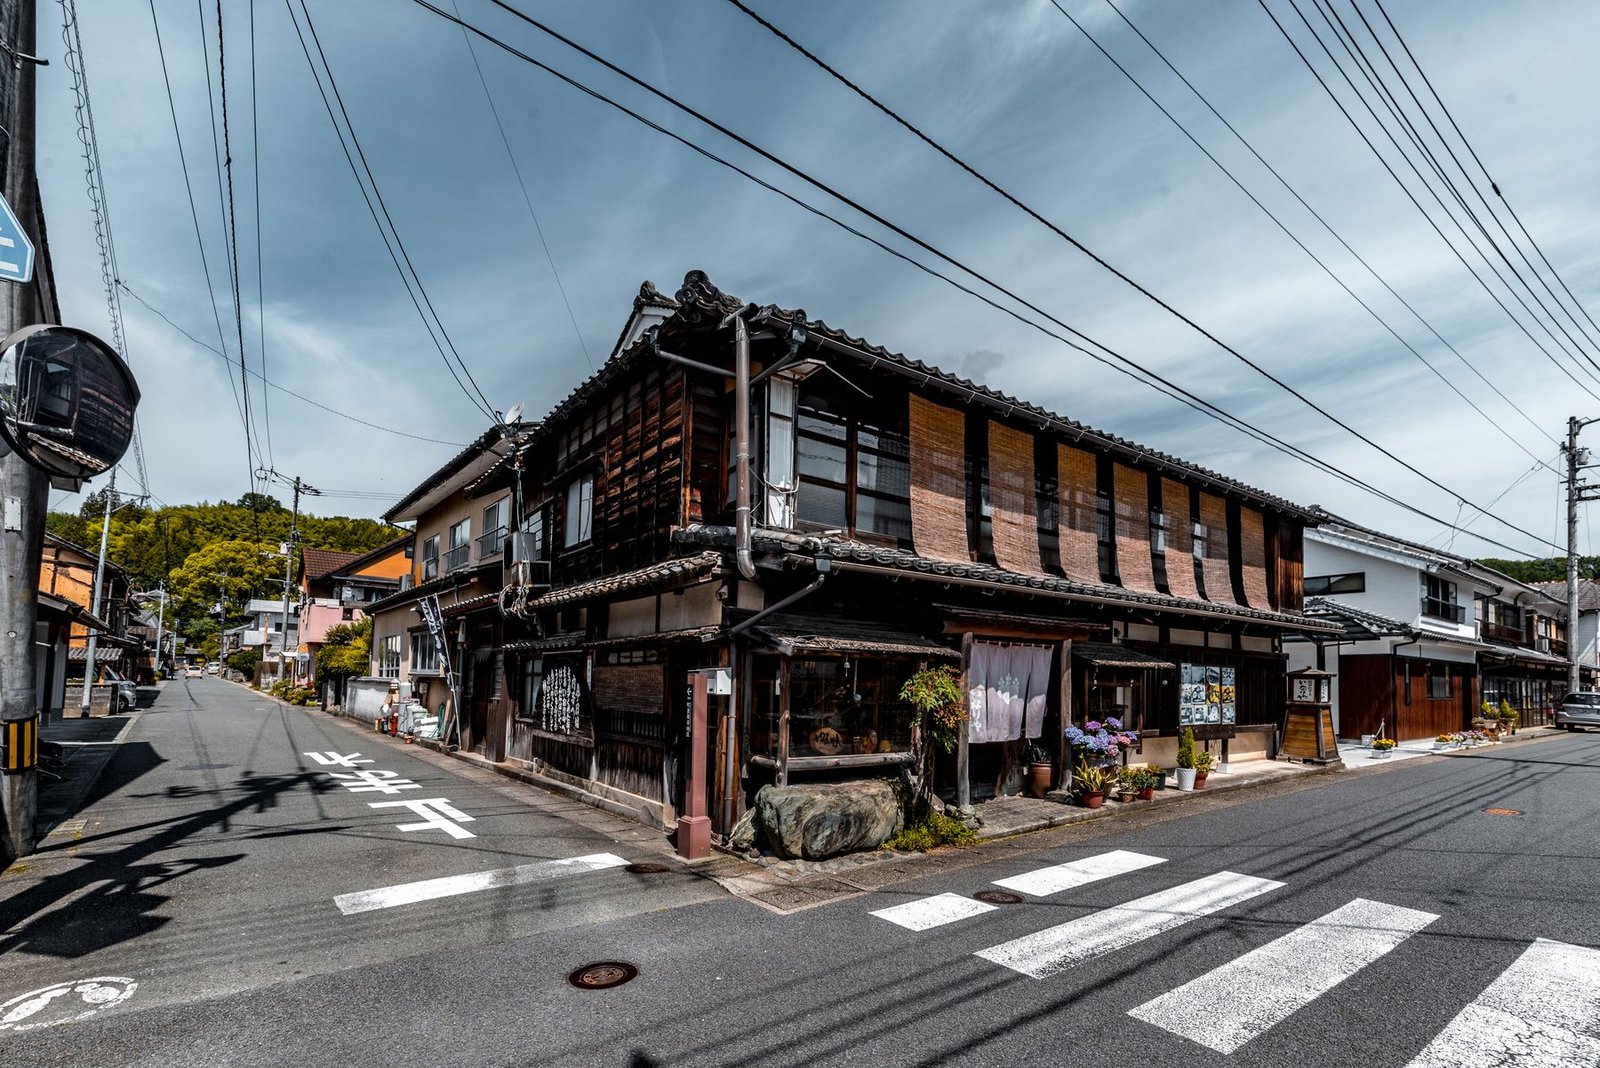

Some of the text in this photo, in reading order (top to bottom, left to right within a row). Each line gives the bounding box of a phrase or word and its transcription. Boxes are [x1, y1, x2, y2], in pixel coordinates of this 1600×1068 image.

[1297, 680, 1308, 699] いなりや
[304, 751, 476, 839] 止まれ
